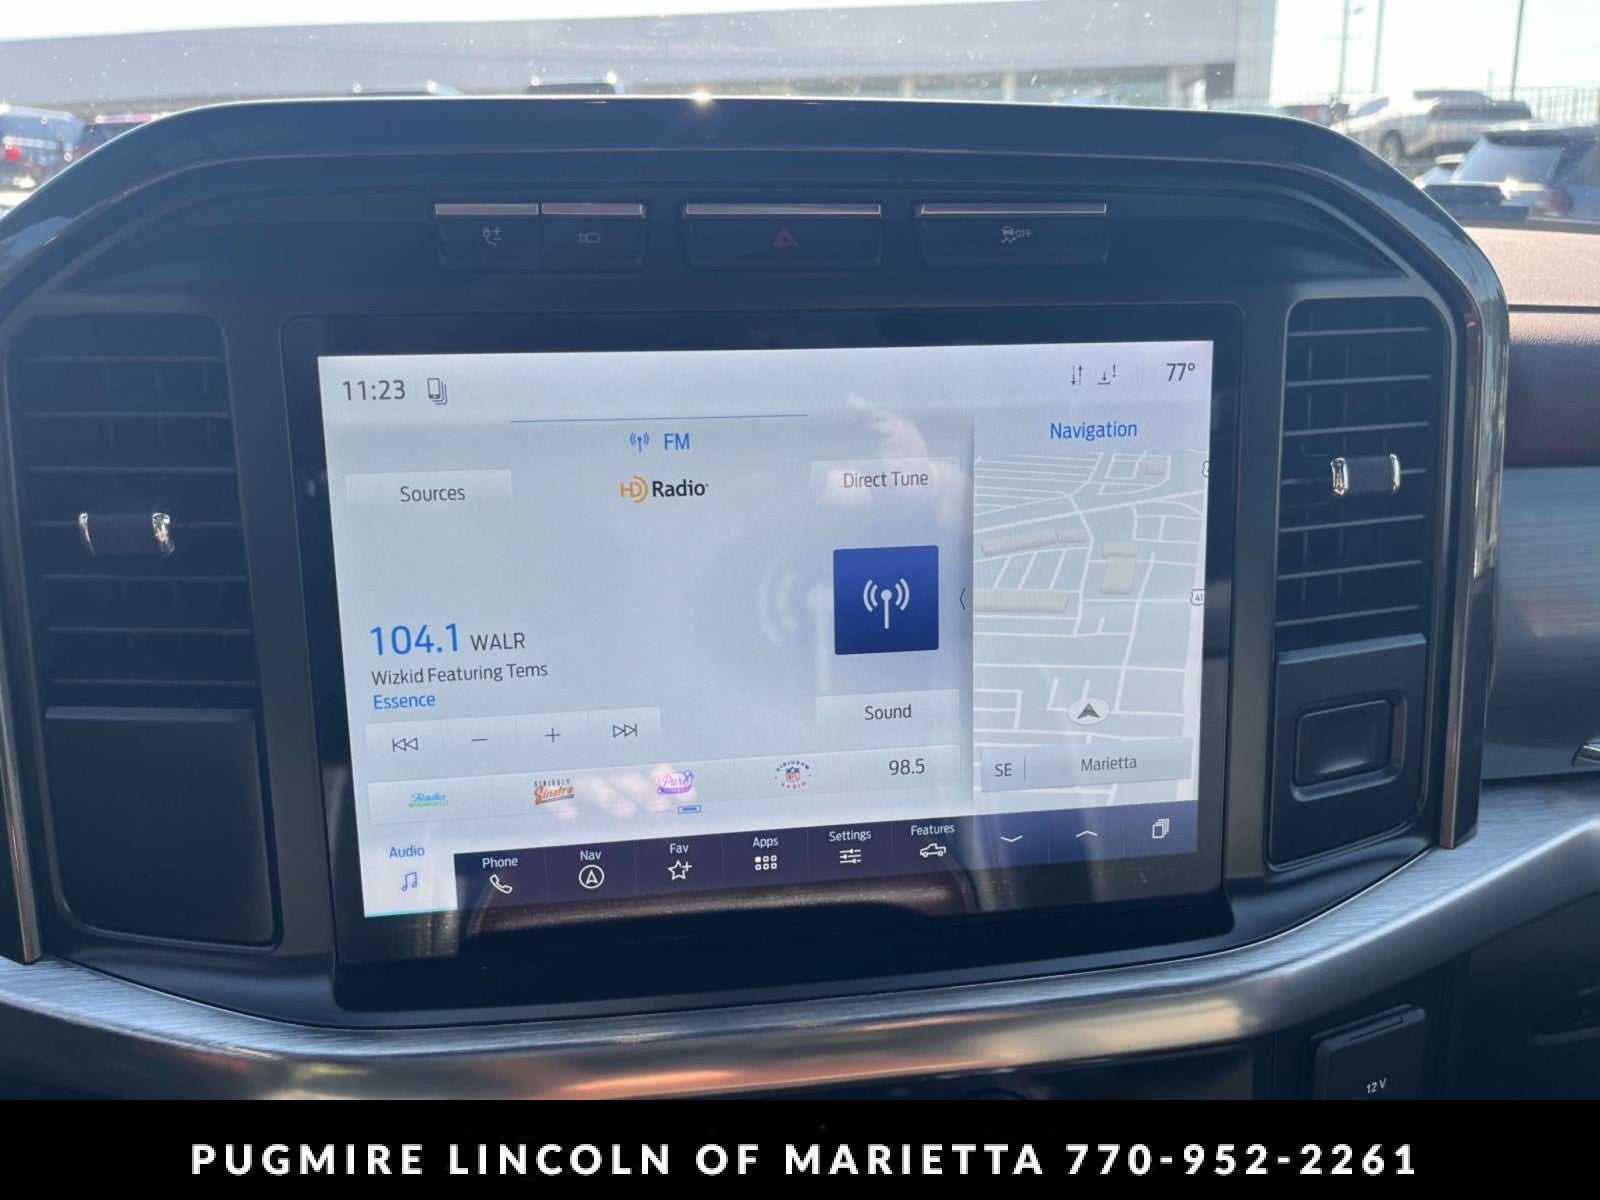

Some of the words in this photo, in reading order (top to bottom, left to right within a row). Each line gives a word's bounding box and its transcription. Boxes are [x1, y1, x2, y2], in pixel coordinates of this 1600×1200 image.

[1014, 229, 1033, 238] OFF
[341, 380, 407, 401] 11:23
[1049, 421, 1138, 442] Navigation
[663, 433, 691, 451] FM
[652, 478, 706, 498] Radio
[843, 472, 888, 488] Direct
[891, 471, 929, 487] Tune
[399, 485, 467, 503] Sources
[370, 623, 460, 656] 104.1
[470, 632, 527, 652] WALR
[371, 668, 425, 686] Wizkid
[427, 664, 504, 683] Featuring
[505, 662, 549, 679] Tems
[372, 693, 437, 710] Essence
[864, 703, 913, 721] Sound
[888, 757, 926, 776] 98.5
[994, 762, 1013, 777] SE
[1080, 755, 1138, 772] Marietta
[829, 829, 872, 843] Settings
[910, 823, 956, 837] Features
[669, 843, 690, 855] Fav
[752, 836, 779, 849] Apps
[389, 845, 426, 858] Audio
[579, 850, 602, 862] Nav
[482, 856, 519, 869] Phone
[1366, 1081, 1379, 1095] 12
